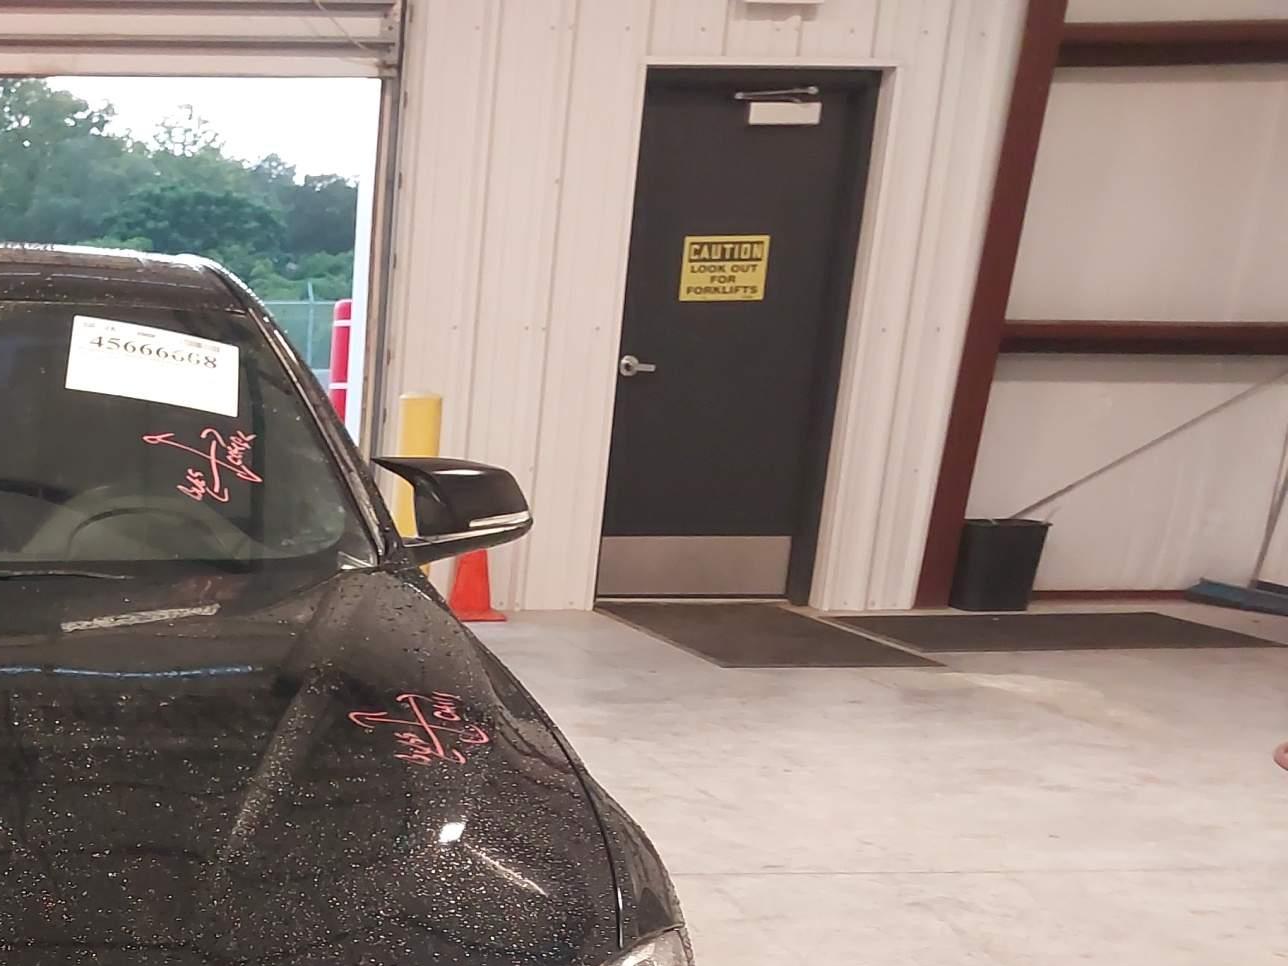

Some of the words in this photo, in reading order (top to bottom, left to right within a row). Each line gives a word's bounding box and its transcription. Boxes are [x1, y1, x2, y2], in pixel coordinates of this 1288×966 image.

[690, 244, 763, 259] CAUTION
[690, 265, 726, 273] LOOK
[731, 264, 757, 273] OUT
[710, 275, 736, 284] FOR
[686, 286, 757, 295] FORKLIFTS
